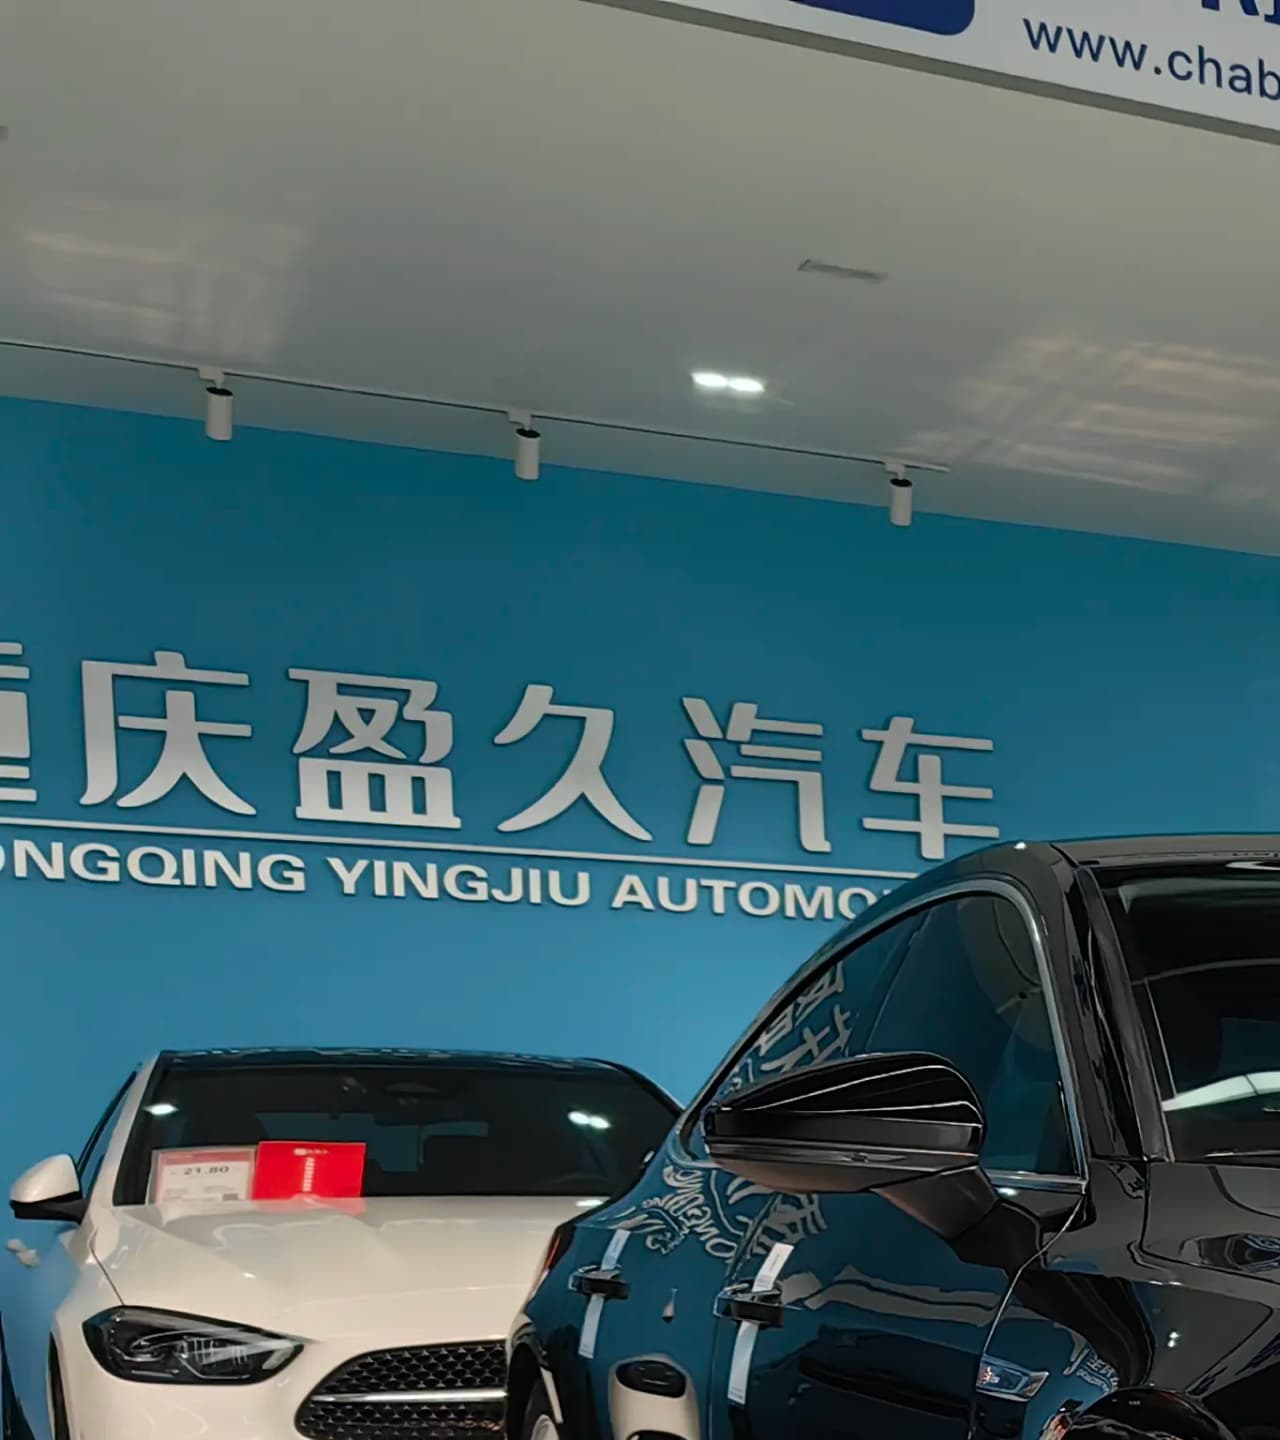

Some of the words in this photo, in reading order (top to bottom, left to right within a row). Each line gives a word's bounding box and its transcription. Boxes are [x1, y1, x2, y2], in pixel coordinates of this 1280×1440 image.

[0, 642, 1000, 861] 庆盈久汽车
[0, 839, 306, 892] NGQING
[325, 855, 591, 907] YINGJIU
[610, 873, 892, 921] AUTOMO
